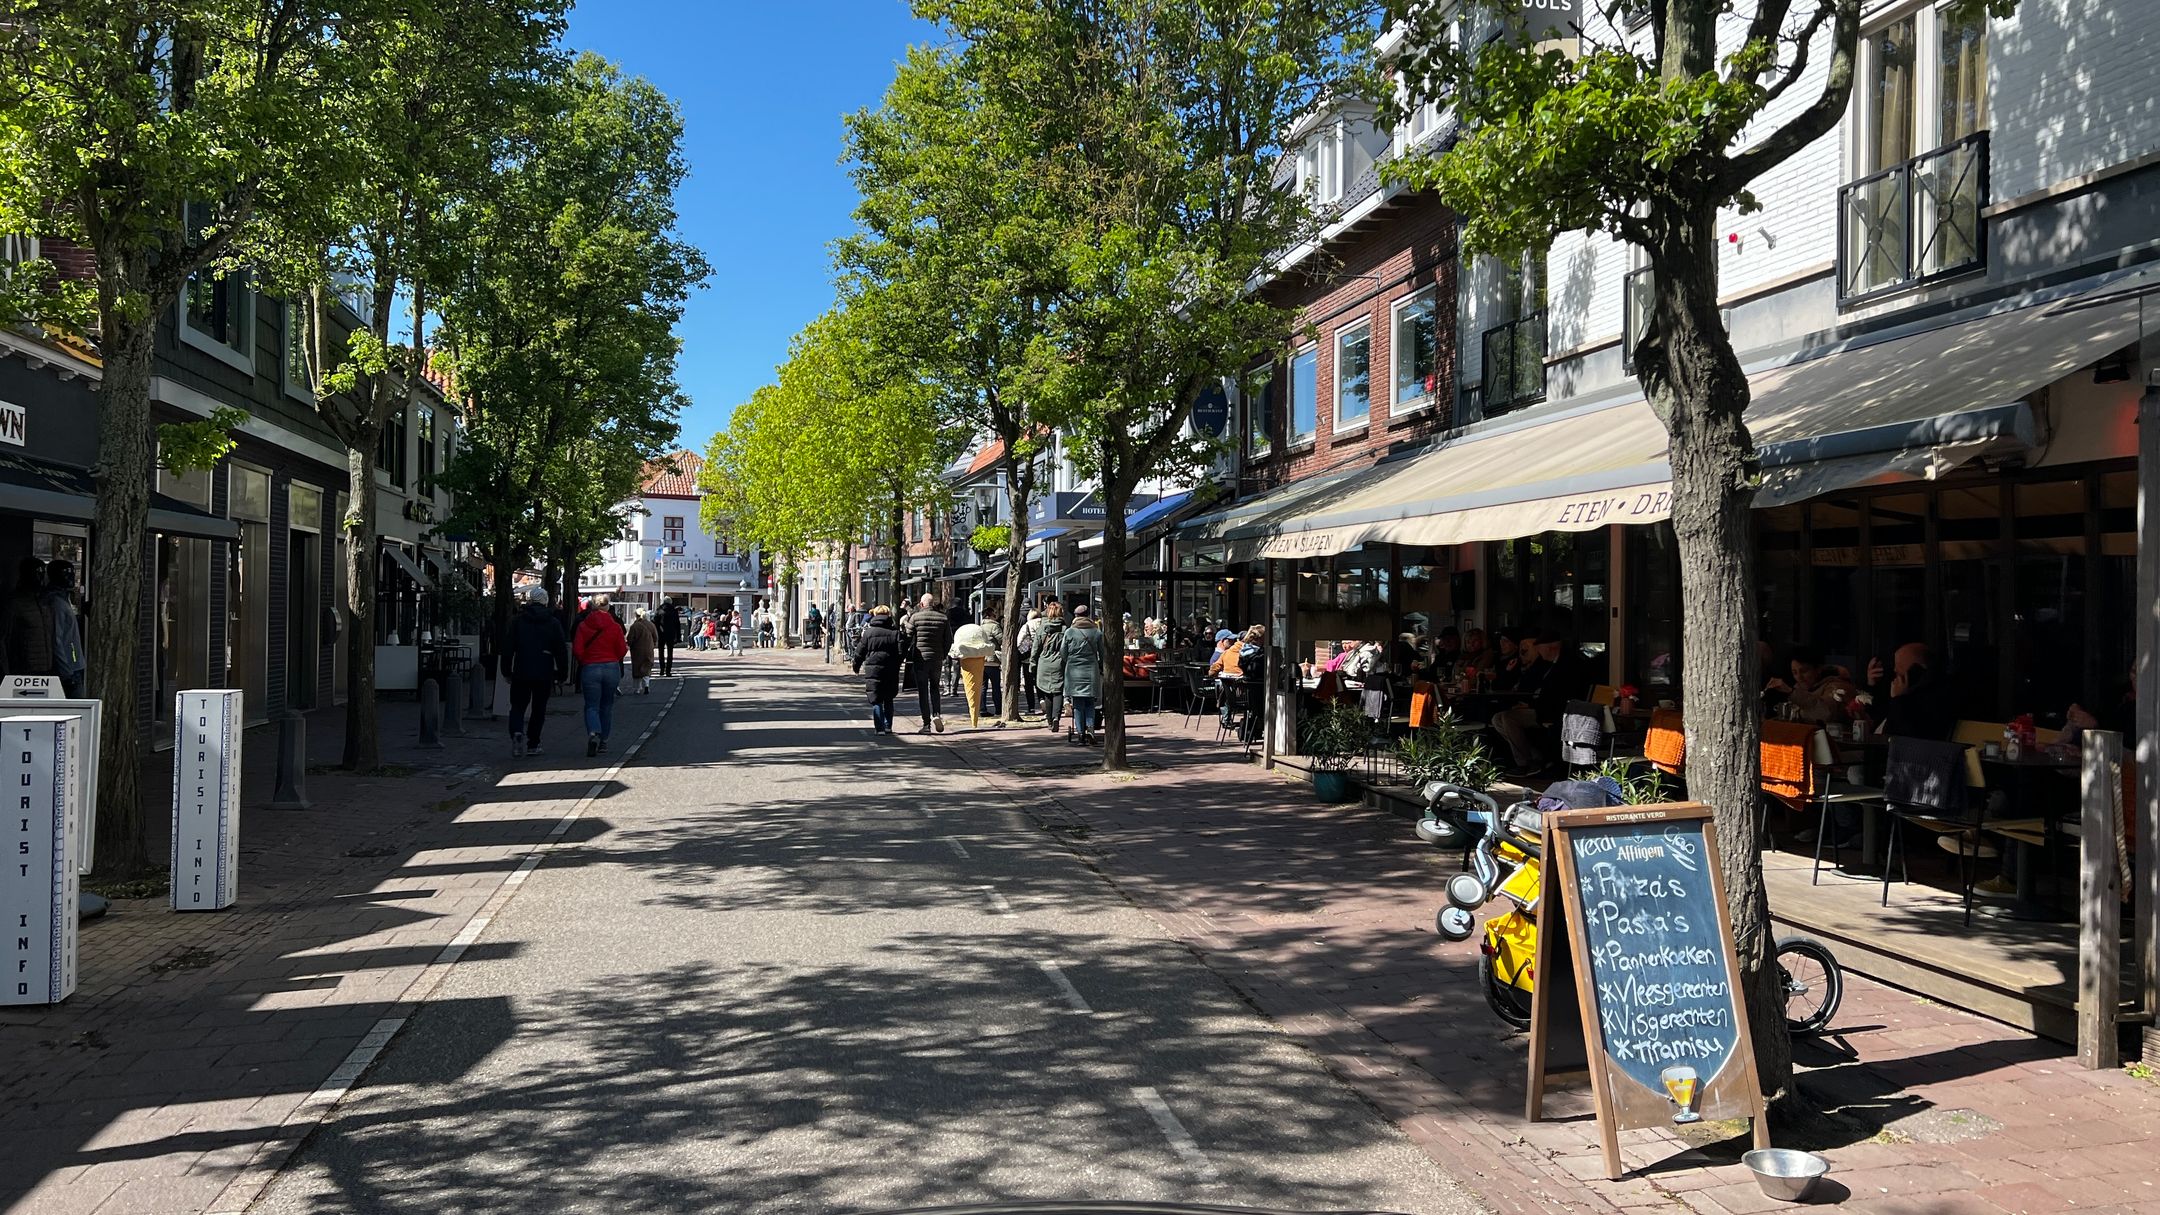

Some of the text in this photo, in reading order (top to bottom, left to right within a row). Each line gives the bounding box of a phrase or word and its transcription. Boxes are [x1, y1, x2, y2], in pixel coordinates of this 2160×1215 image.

[1082, 507, 1106, 515] HOTEL
[1557, 498, 1615, 523] ETEN
[1300, 534, 1333, 552] SLAPEN
[670, 560, 706, 571] ROODE
[14, 677, 50, 687] OPEN
[193, 699, 207, 903] TOURIST INFO
[1606, 812, 1646, 821] RISTORANTE
[1573, 835, 1617, 859] Verdi
[1616, 845, 1664, 862] Affligem
[18, 728, 32, 995] TOURIST INFO
